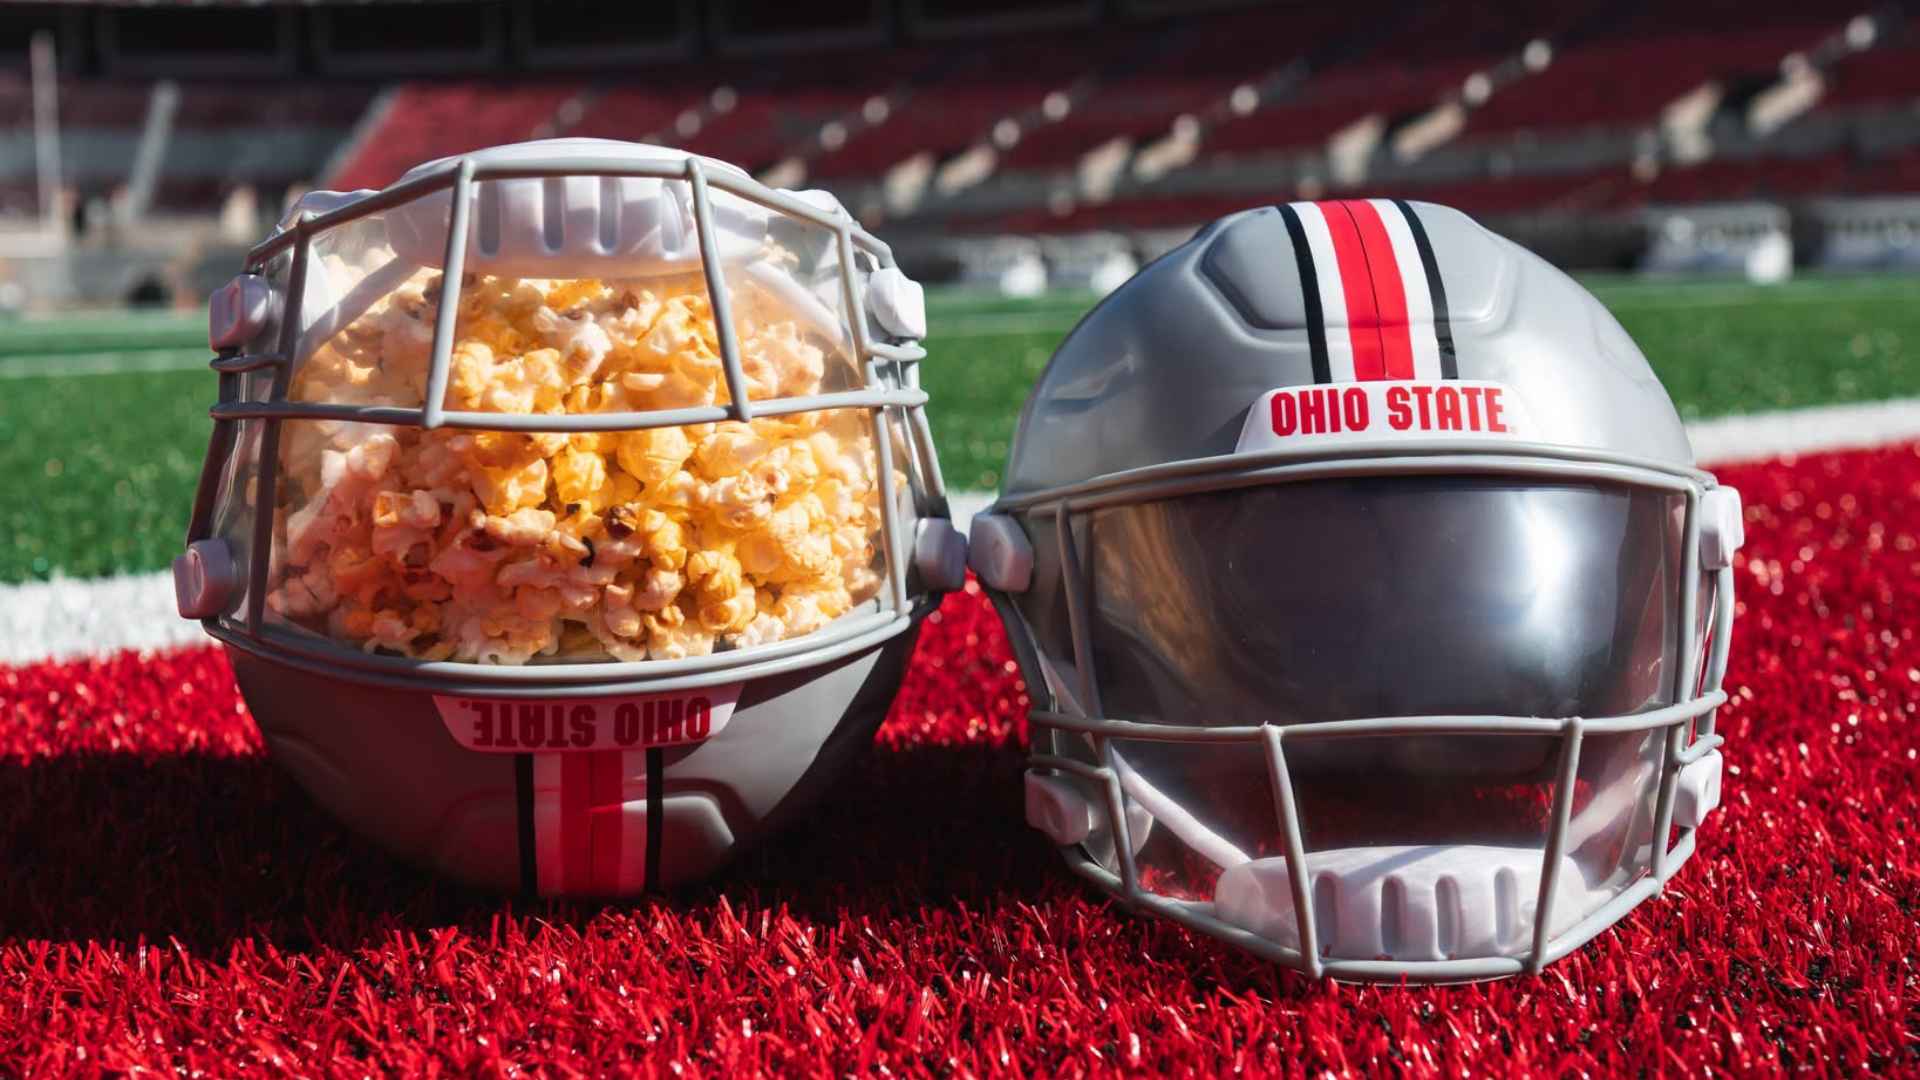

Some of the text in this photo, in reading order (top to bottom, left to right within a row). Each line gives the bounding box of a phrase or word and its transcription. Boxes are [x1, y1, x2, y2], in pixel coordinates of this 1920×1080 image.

[1270, 386, 1510, 437] OHIO STATE
[613, 697, 712, 748] OHIO
